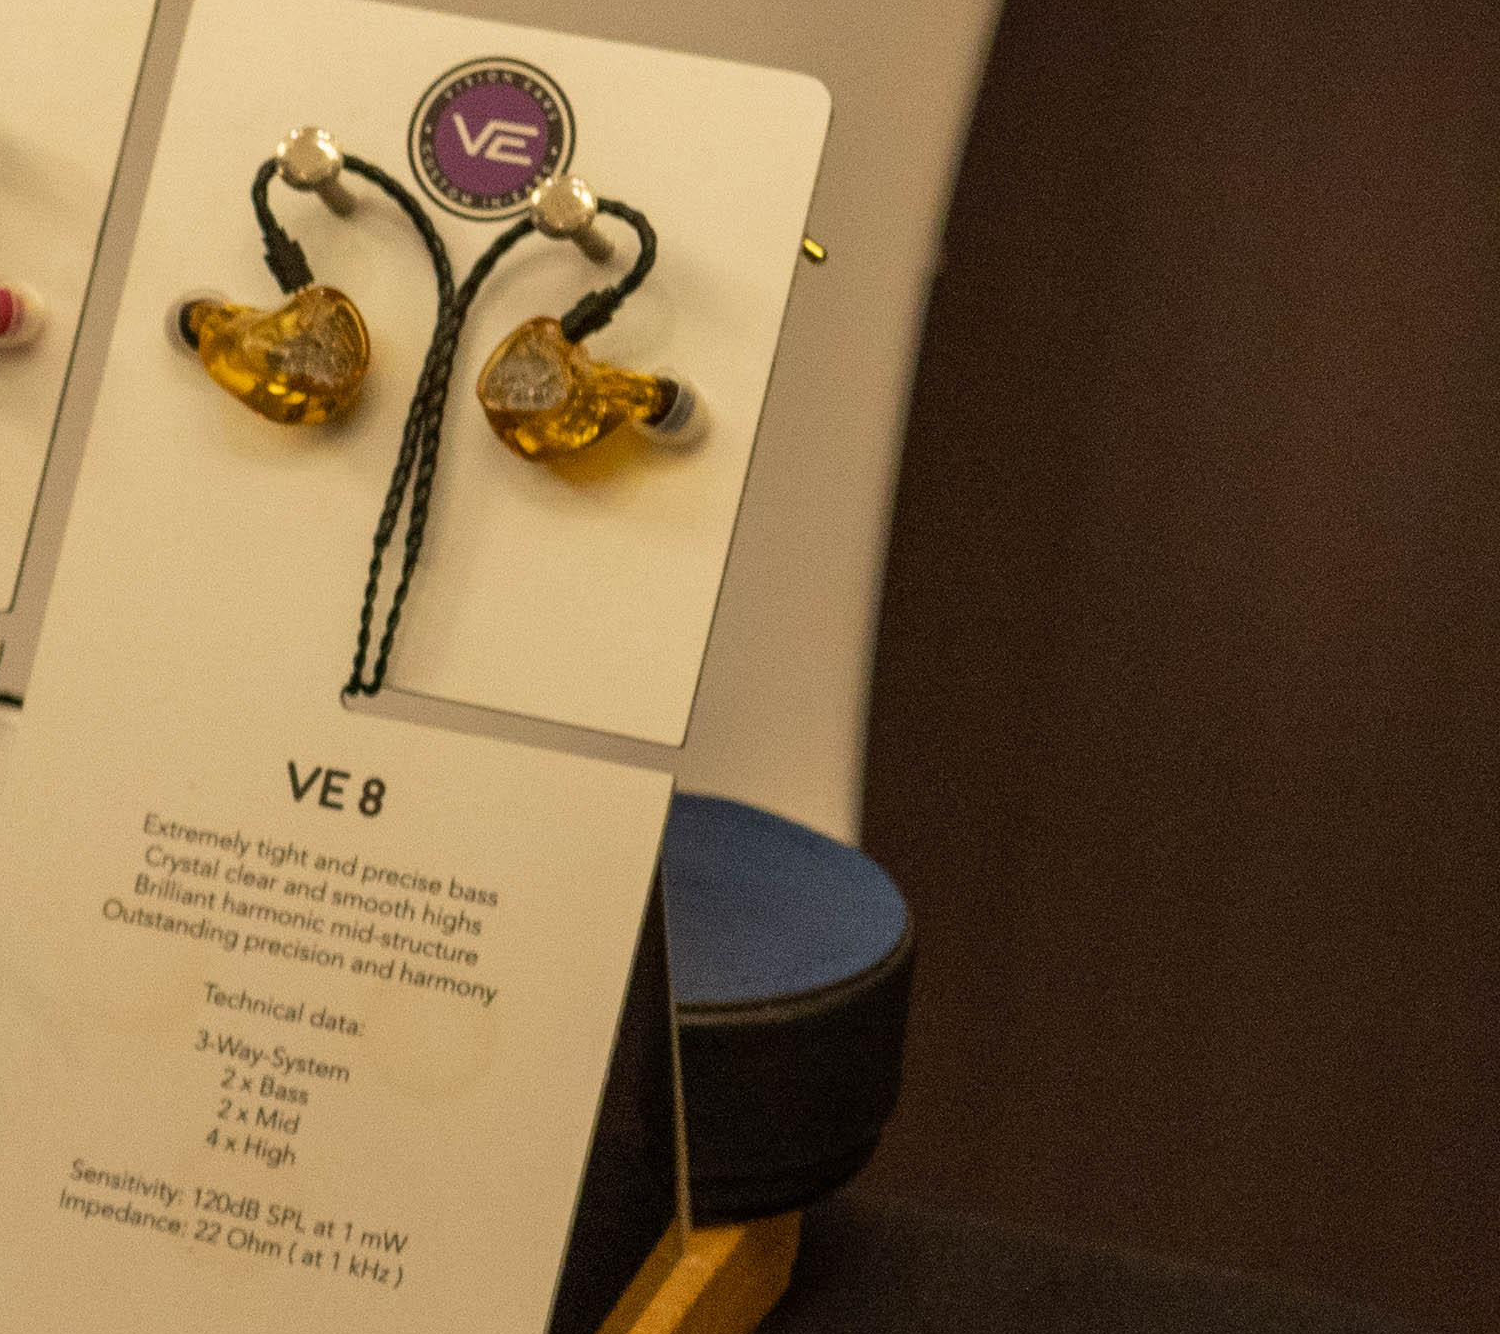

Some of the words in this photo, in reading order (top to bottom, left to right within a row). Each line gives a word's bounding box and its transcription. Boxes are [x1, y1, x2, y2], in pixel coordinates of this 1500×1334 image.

[451, 110, 541, 167] VE
[288, 761, 350, 810] VE
[358, 777, 386, 817] 8
[143, 812, 251, 858] Extremely
[257, 840, 308, 867] tight
[314, 855, 358, 877] and
[361, 865, 442, 895] precise
[448, 878, 498, 907] bass
[144, 845, 220, 877] Crystal
[225, 864, 277, 889] clear
[284, 881, 327, 901] and
[332, 891, 415, 920] smooth
[422, 904, 482, 935] highs
[134, 873, 215, 909] Brilliant
[222, 893, 324, 933] harmonic
[331, 922, 479, 966] mid-structure
[102, 898, 239, 951] Outstanding
[243, 935, 344, 968] precision
[351, 958, 395, 980] and
[399, 962, 498, 1008] harmony
[205, 982, 305, 1022] Technical
[217, 1098, 233, 1120] 2
[237, 1109, 247, 1122] x
[256, 1107, 300, 1134] Mid
[221, 1067, 236, 1089] 2
[241, 1078, 252, 1091] x
[259, 1075, 308, 1105] Bass
[206, 1128, 219, 1147] 4
[225, 1138, 236, 1152] x
[243, 1136, 296, 1168] High
[193, 1219, 222, 1245] 22
[226, 1228, 282, 1257] Ohm
[301, 1251, 323, 1268] at
[333, 1251, 341, 1271] 1
[348, 1255, 390, 1284] kHz
[195, 1188, 260, 1220] 120dB
[267, 1204, 305, 1233] SPL
[313, 1221, 335, 1238] at
[345, 1222, 353, 1242] 1
[361, 1231, 408, 1254] mW
